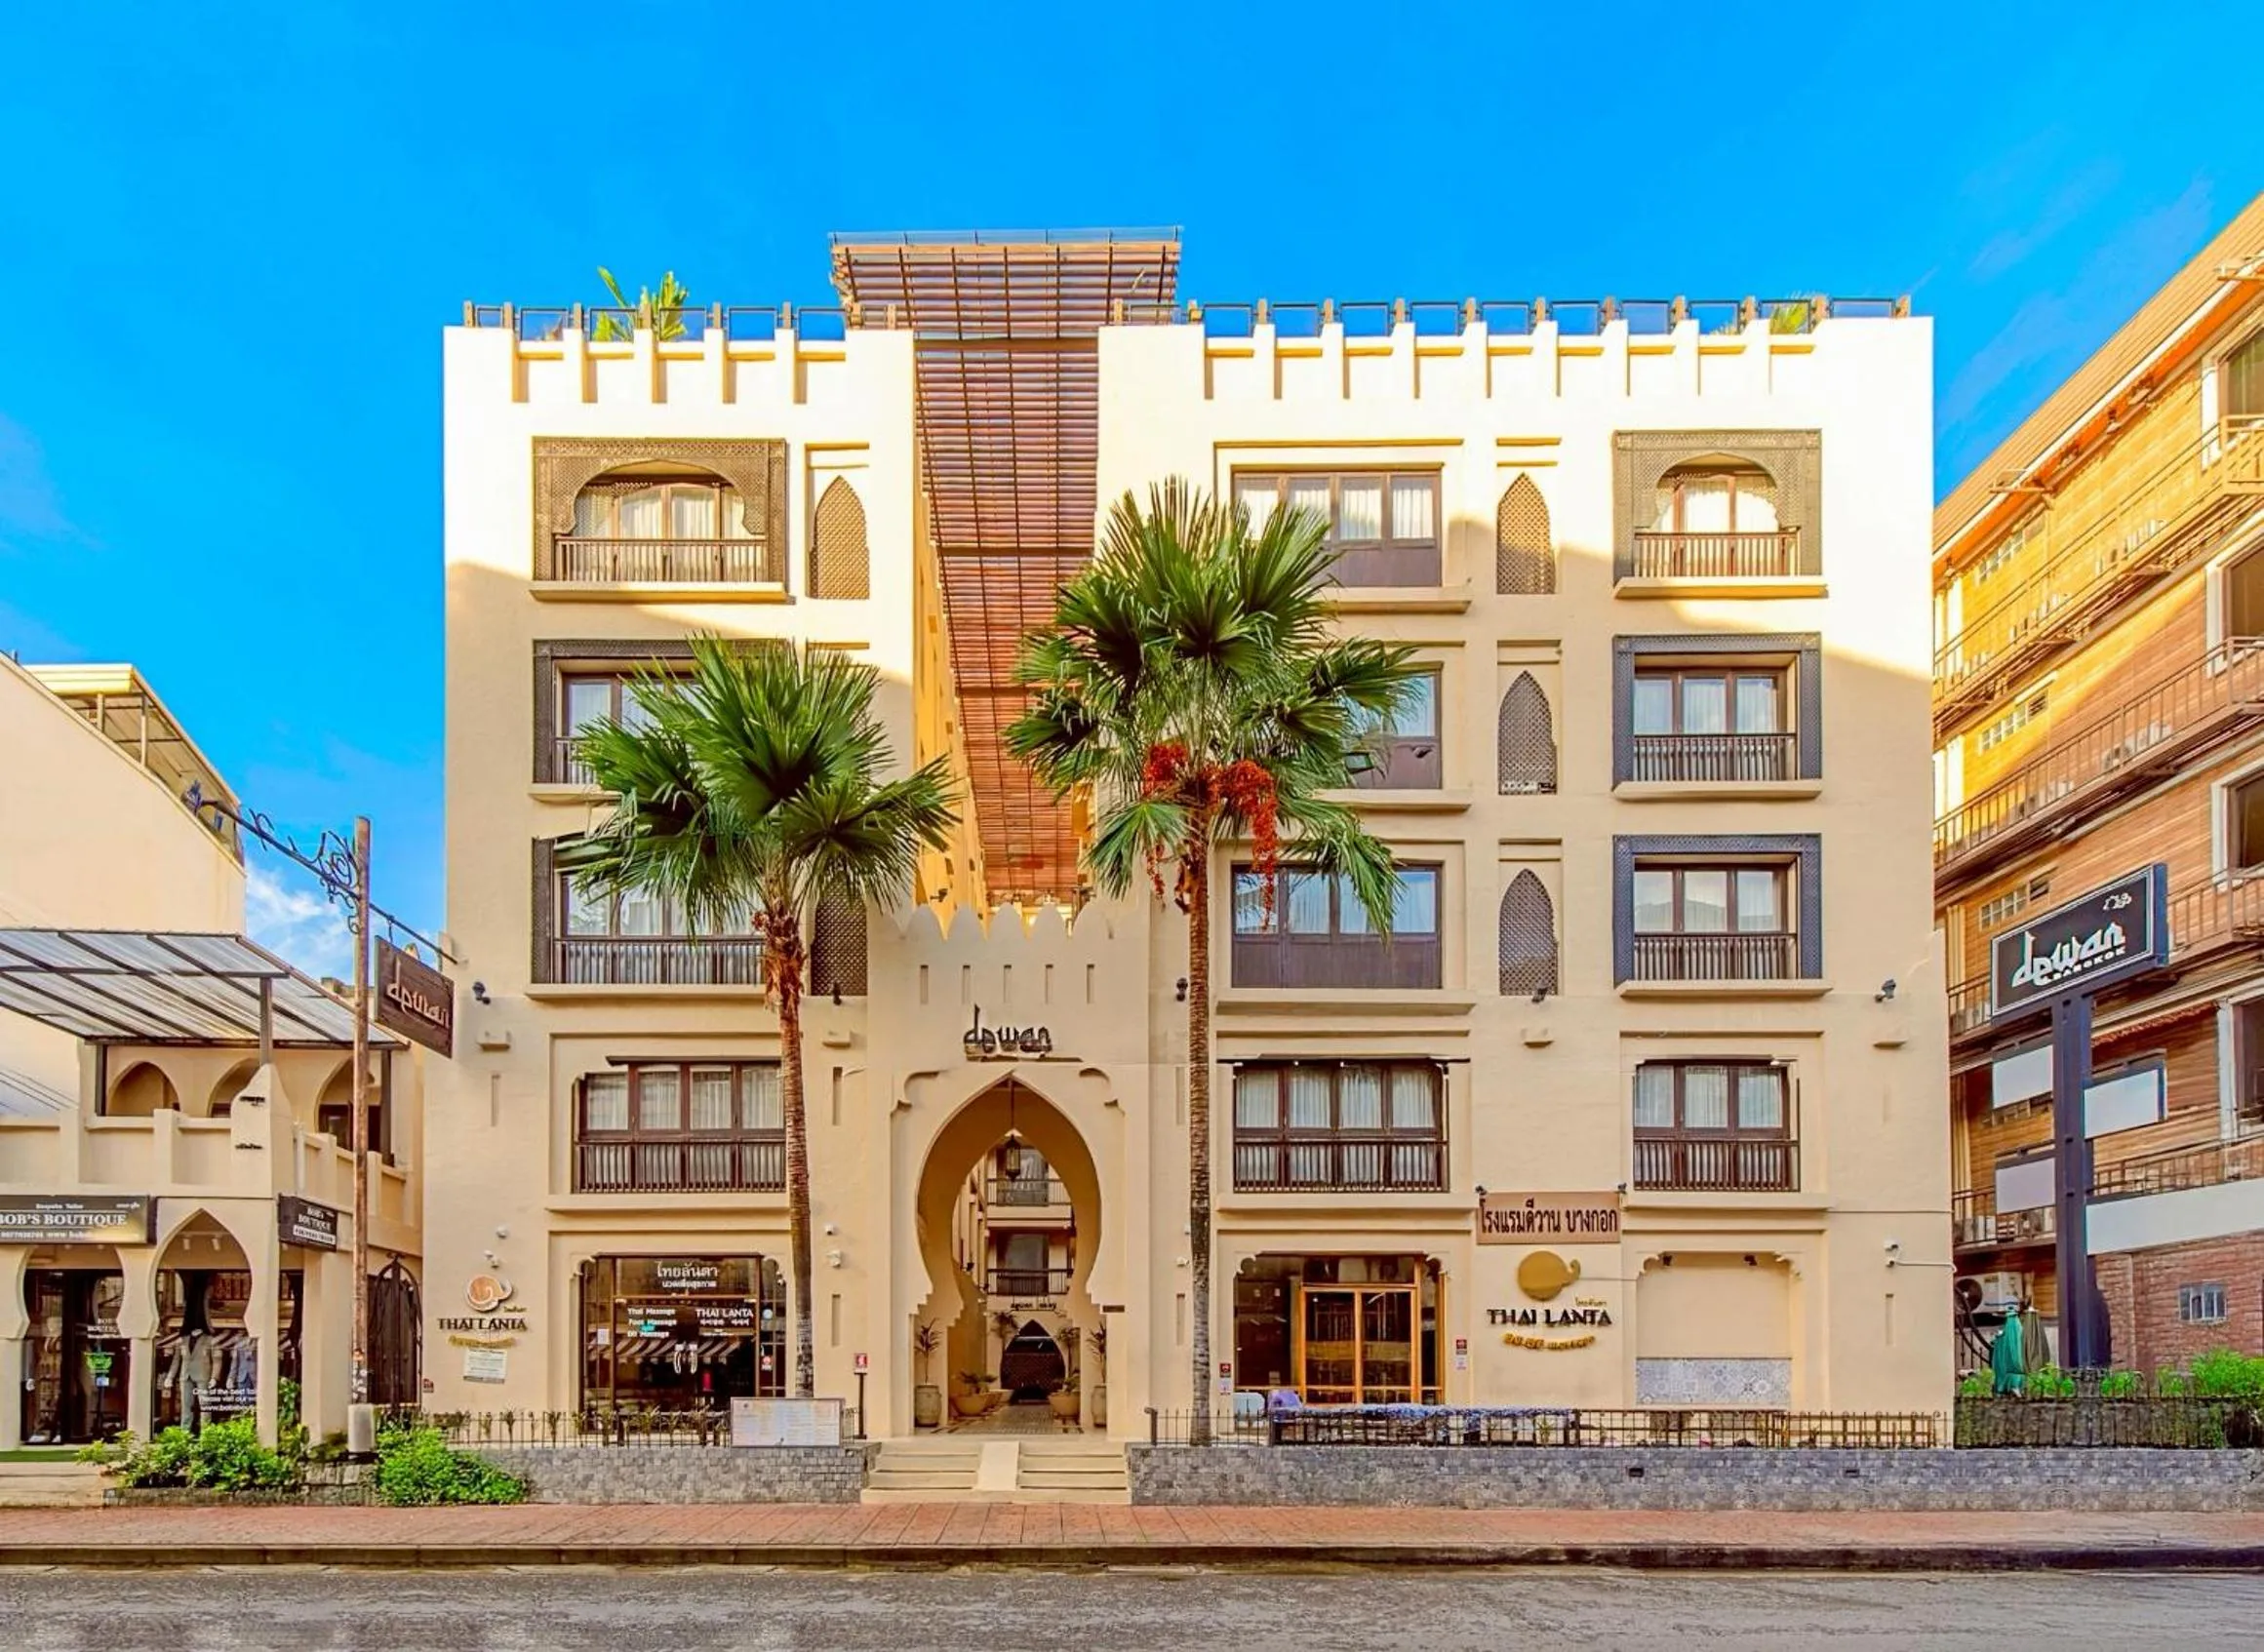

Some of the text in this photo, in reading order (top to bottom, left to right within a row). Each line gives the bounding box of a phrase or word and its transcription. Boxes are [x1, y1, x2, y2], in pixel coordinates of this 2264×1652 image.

[2011, 922, 2126, 988] dewan
[963, 1003, 1053, 1054] dewan
[43, 1213, 128, 1228] BOUTIQUE
[1566, 1208, 1617, 1233] บางกอก
[695, 1307, 754, 1318] THAI LANTA
[1487, 1309, 1612, 1326] THAI LANTA
[437, 1318, 529, 1332] THAI LANTA
